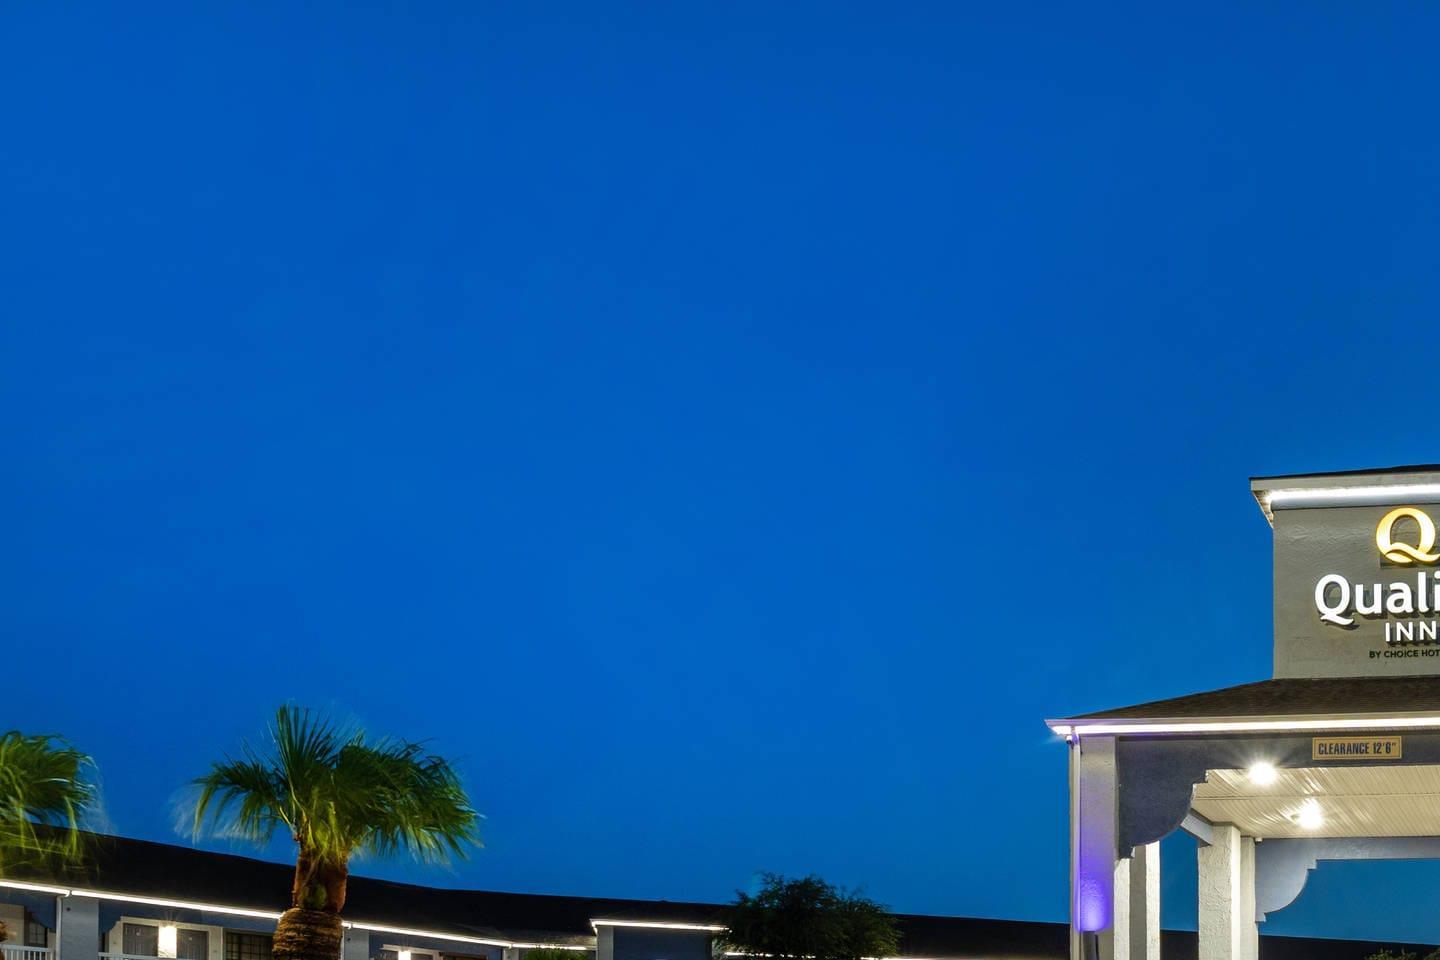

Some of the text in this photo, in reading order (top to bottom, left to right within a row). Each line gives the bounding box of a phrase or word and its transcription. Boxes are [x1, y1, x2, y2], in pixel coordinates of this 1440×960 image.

[1376, 507, 1440, 564] Q
[1385, 620, 1437, 642] INN
[1369, 650, 1381, 658] BY
[1384, 649, 1419, 658] CHOICE
[1318, 742, 1370, 755] CLEARANCE
